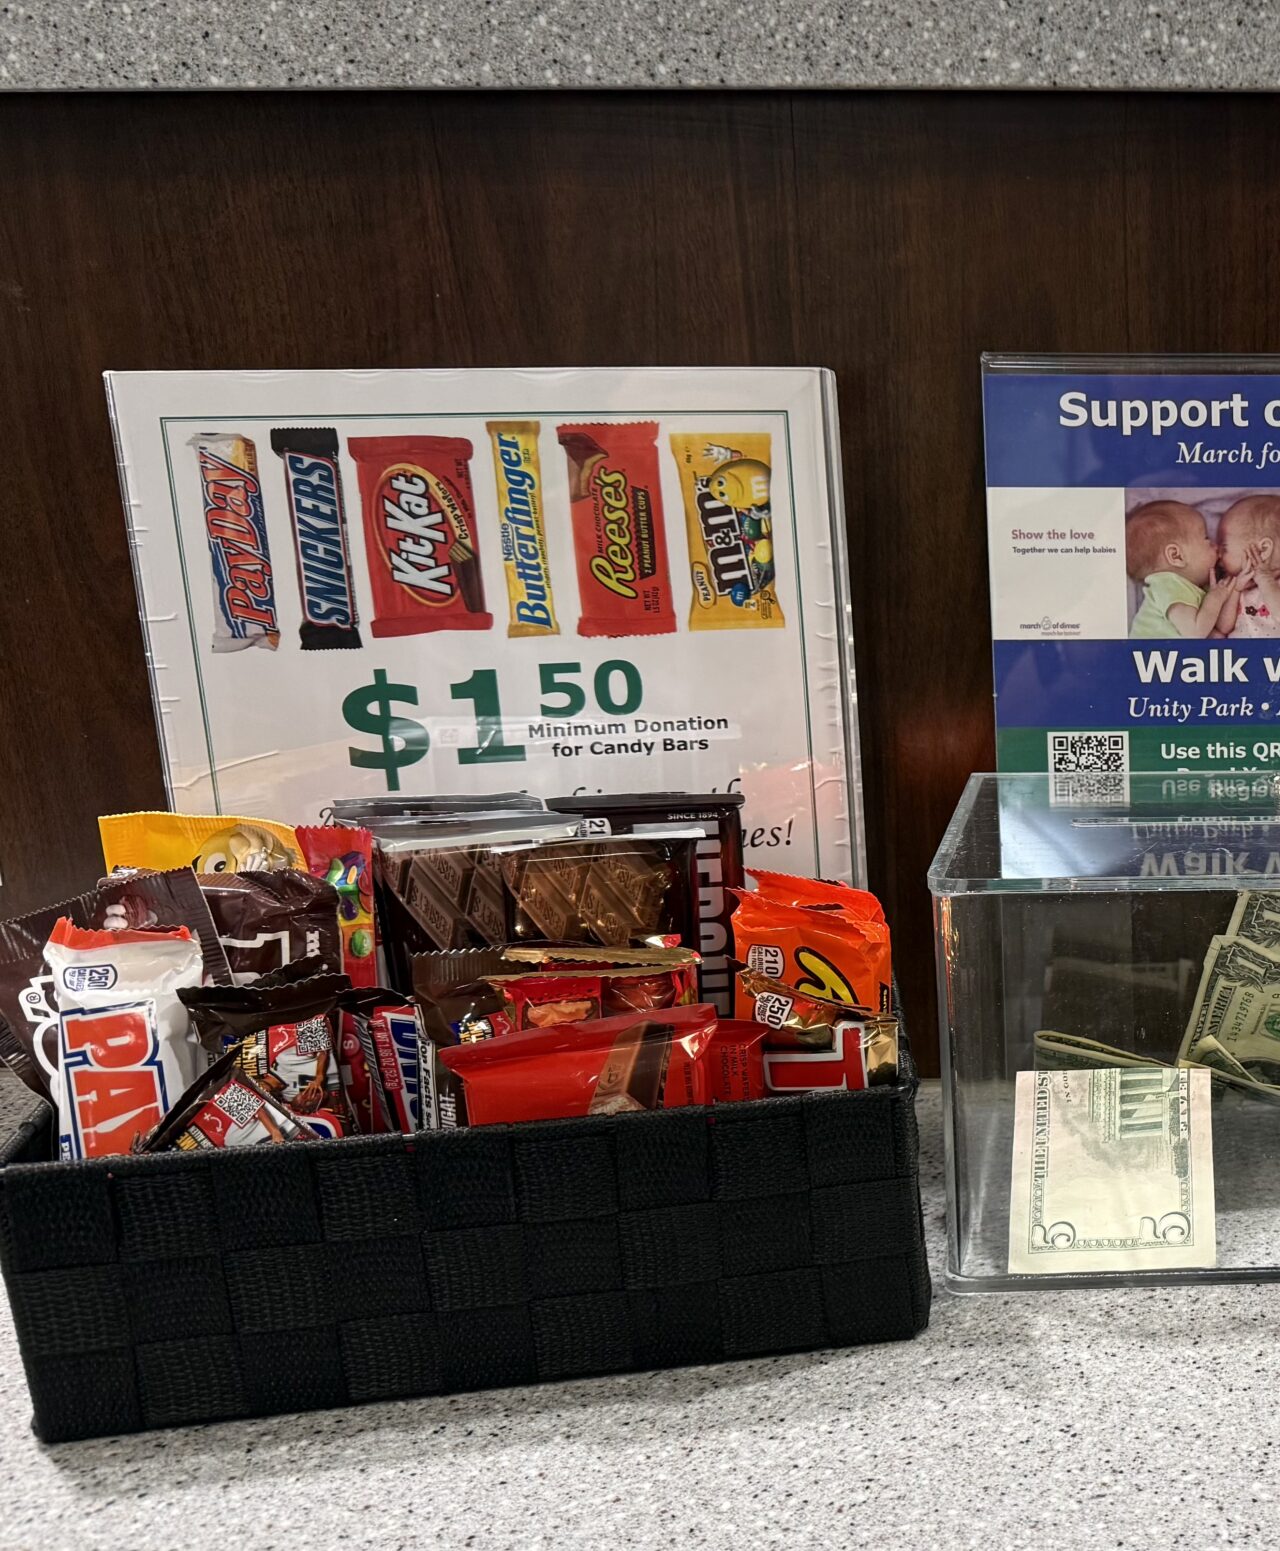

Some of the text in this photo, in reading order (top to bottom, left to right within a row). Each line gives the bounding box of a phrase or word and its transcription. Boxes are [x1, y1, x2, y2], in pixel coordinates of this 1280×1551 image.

[1058, 391, 1249, 436] Support
[1175, 441, 1254, 464] March
[288, 454, 351, 626] SNICKERS
[384, 474, 453, 596] KitKat
[451, 512, 469, 540] Crisp
[497, 432, 553, 629] Butterfinger
[589, 466, 639, 599] Reese's
[636, 491, 652, 568] PEANUT BUTTER CUPS
[1011, 529, 1095, 540] Show the love
[199, 451, 280, 634] PayDay
[1012, 546, 1045, 555] Together
[1074, 546, 1091, 555] help
[1092, 546, 1117, 554] babies
[693, 570, 710, 602] PEANUT
[1132, 649, 1249, 684] Walk
[538, 659, 644, 718] 50
[1127, 696, 1192, 722] Unity
[1199, 696, 1254, 717] Park
[341, 668, 527, 791] $1
[528, 716, 729, 739] Minimum Donation
[552, 736, 709, 760] for Candy Bars
[1160, 742, 1200, 759] Use
[1206, 741, 1246, 758] this
[667, 811, 718, 820] SINCE 1894
[764, 949, 779, 977] 210
[89, 967, 110, 991] 250
[767, 996, 790, 1027] 250
